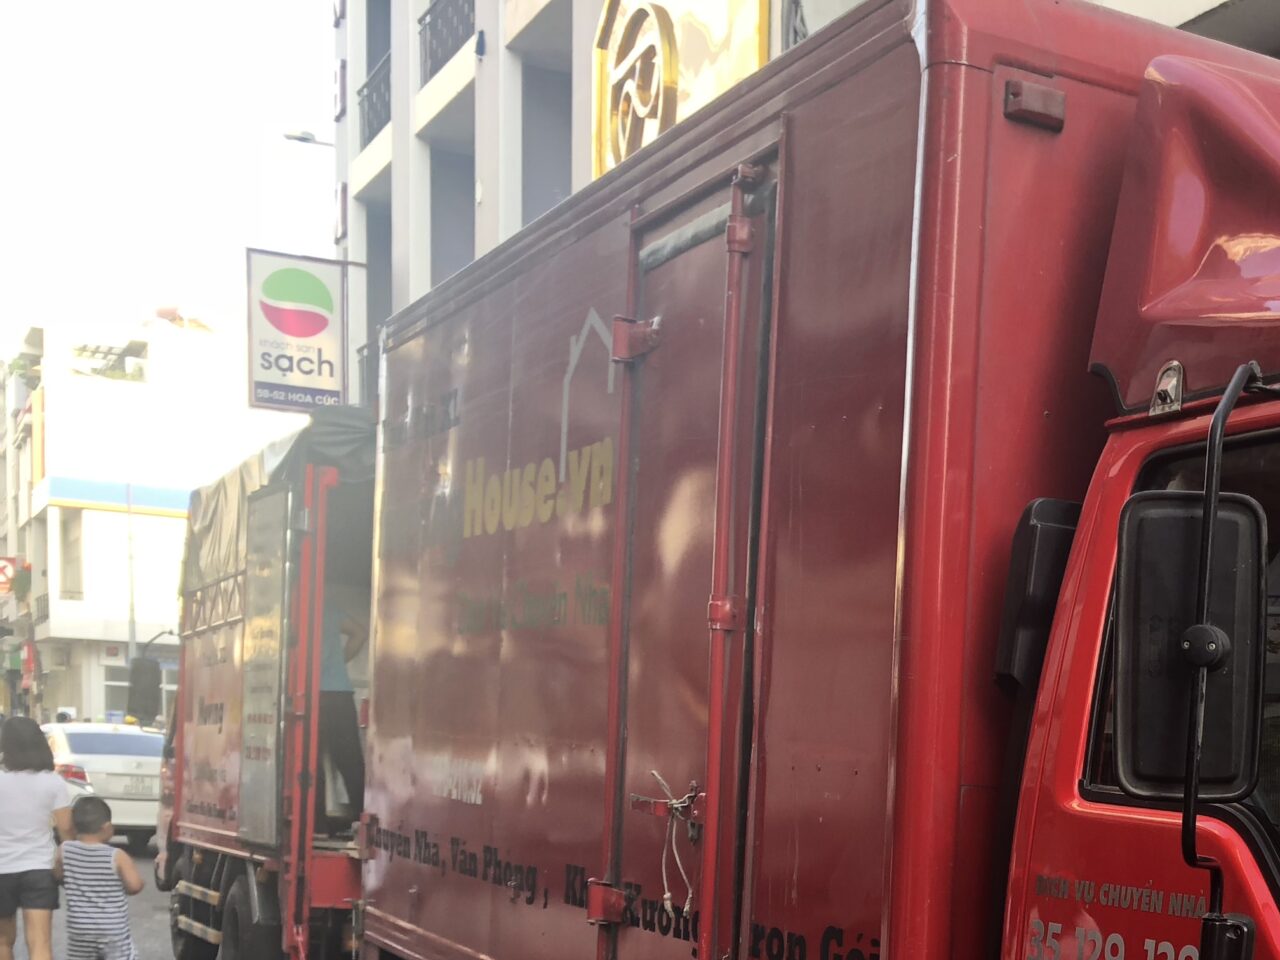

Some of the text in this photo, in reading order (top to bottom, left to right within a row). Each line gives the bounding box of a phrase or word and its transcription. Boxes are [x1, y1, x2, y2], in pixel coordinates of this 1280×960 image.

[260, 347, 334, 378] sạch
[288, 391, 313, 403] HOA
[463, 436, 613, 539] House.vn
[1074, 880, 1096, 909] VỤ
[1100, 880, 1164, 914] CHUYỂN
[1167, 889, 1207, 919] NHÀ
